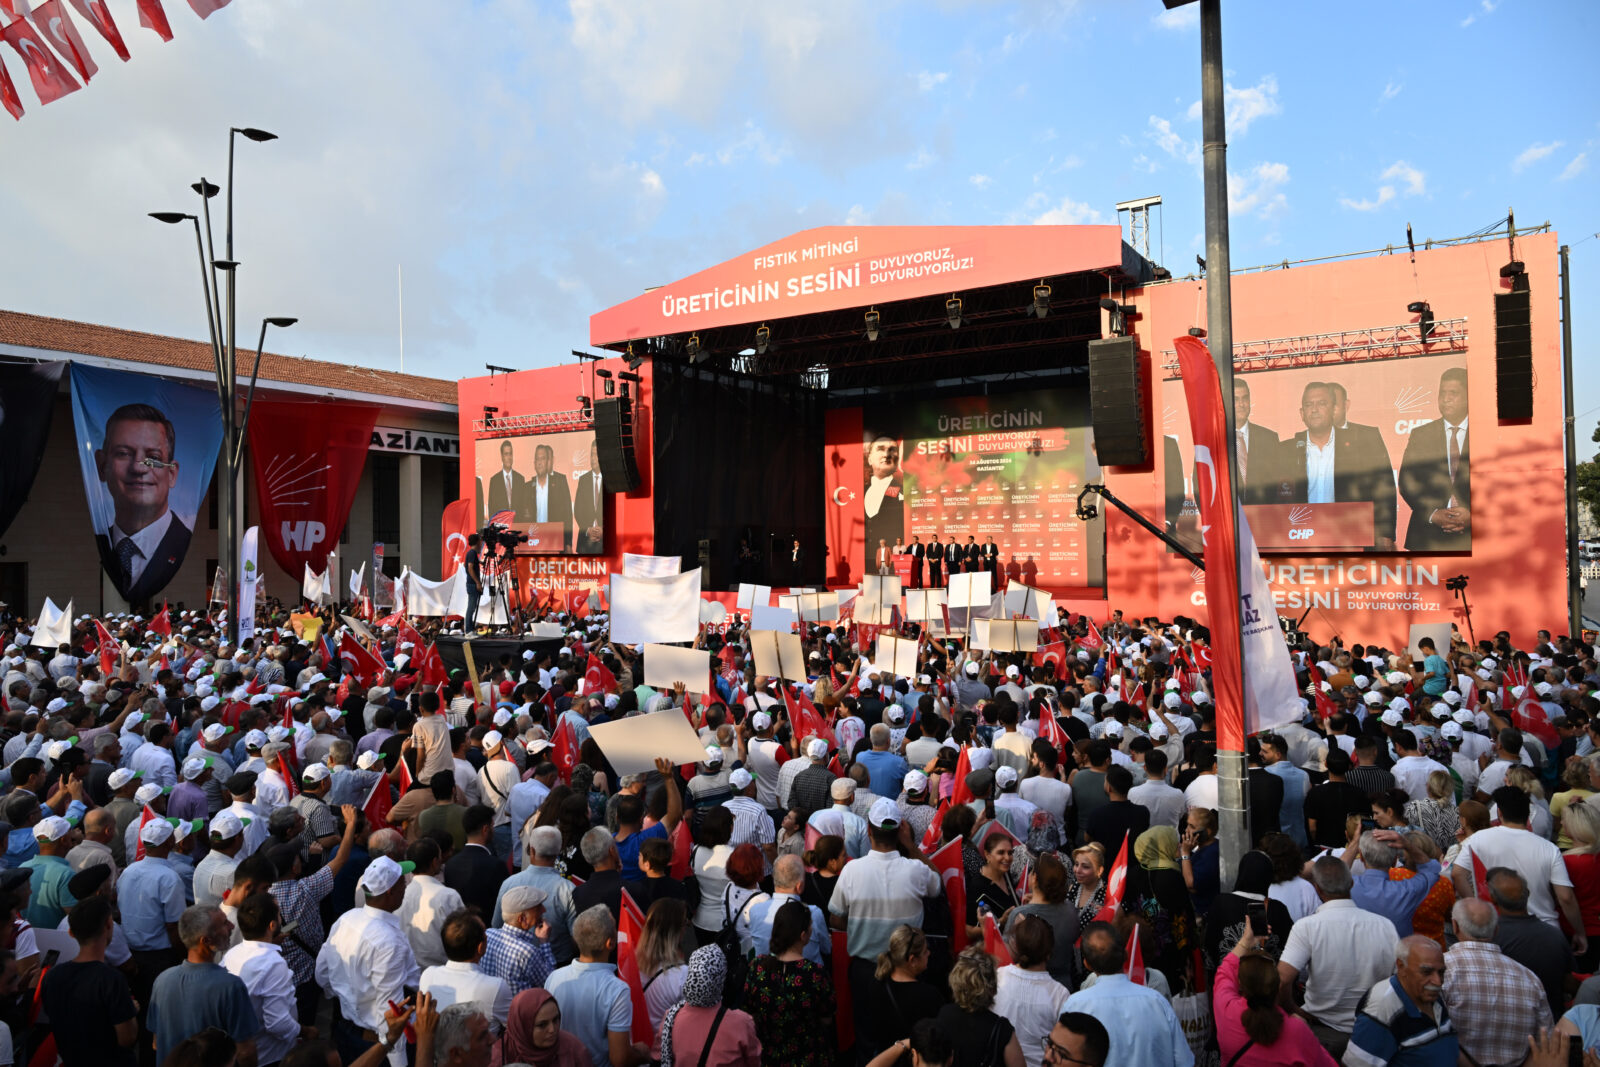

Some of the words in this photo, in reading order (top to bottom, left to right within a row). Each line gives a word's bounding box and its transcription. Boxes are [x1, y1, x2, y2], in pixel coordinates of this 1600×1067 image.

[754, 250, 798, 271] FISTIK
[802, 236, 858, 262] MİTİNGİ
[870, 247, 954, 271] DUYUYORUZ,
[870, 257, 974, 285] DUYURUYORUZ!
[662, 279, 779, 317] ÜRETİCİNİN
[786, 262, 860, 297] SESİNİ
[938, 408, 1043, 432] ÜRETİCİNİN
[368, 430, 459, 454] AZİANT
[917, 435, 972, 455] SESİNİ
[978, 430, 1041, 442] DUYUYORUZ,
[978, 439, 1055, 452] DUYURUYORUZ!
[281, 520, 326, 552] HP
[1288, 528, 1315, 540] CHP
[529, 558, 607, 575] ÜRETİCİNİN
[1263, 560, 1438, 586] ÜRETİCİNİN
[528, 575, 566, 590] SESİNİ
[1272, 587, 1340, 609] ESİNİ
[1347, 591, 1423, 602] DUYUYORUZ,
[1347, 601, 1440, 612] DUYURUYORUZ!
